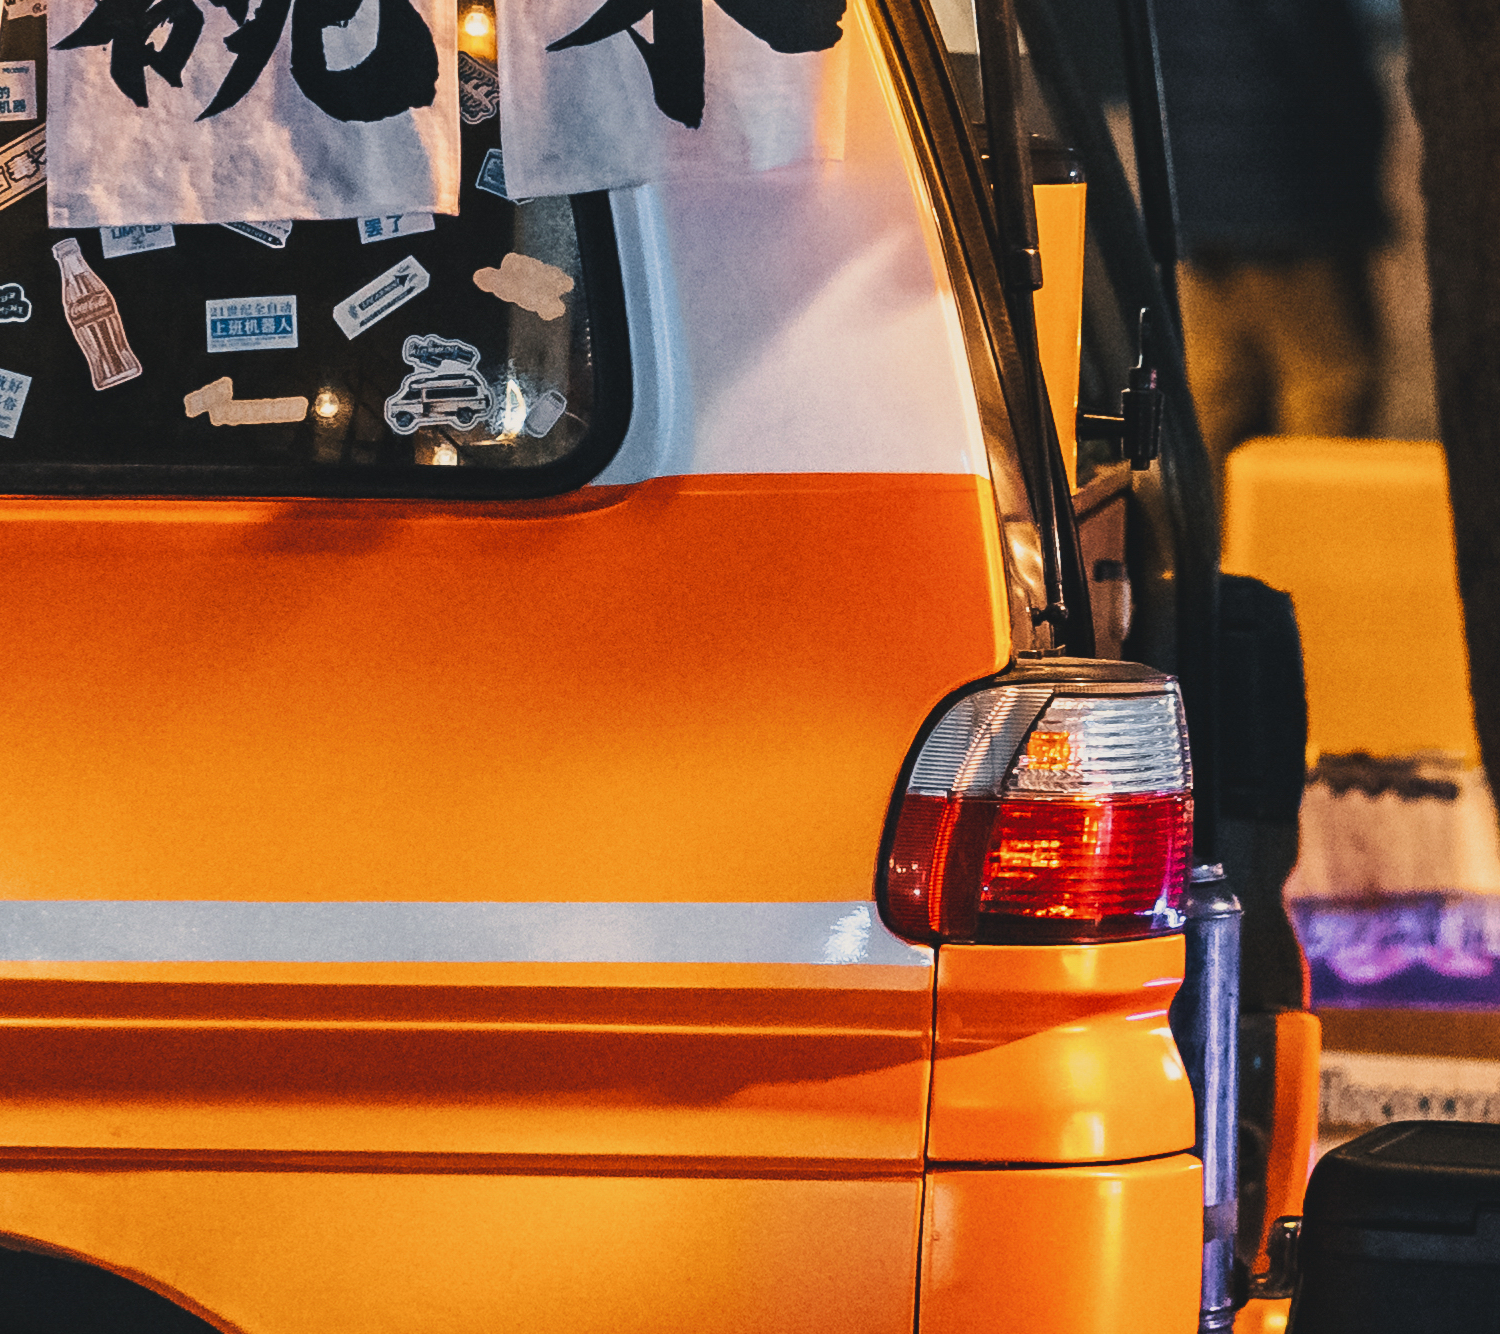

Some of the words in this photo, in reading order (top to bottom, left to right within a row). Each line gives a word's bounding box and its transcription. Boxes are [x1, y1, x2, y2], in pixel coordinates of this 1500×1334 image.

[211, 318, 291, 337] 上班机器人
